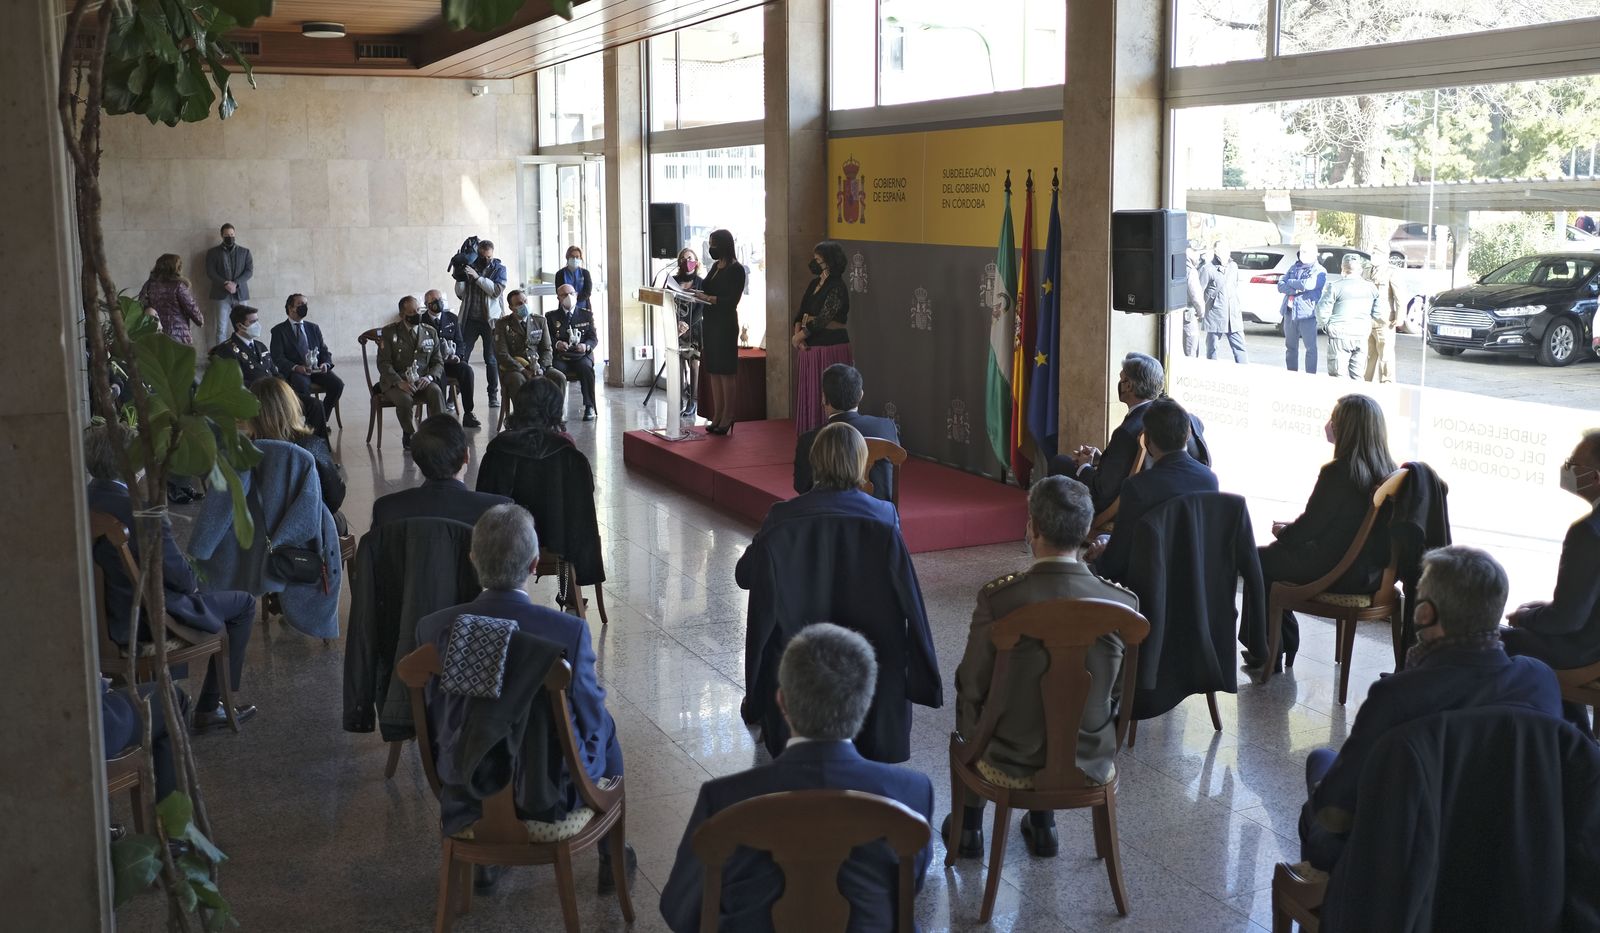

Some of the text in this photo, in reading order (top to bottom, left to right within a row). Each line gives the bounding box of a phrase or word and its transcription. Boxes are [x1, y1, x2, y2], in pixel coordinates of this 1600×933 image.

[942, 165, 997, 178] SUBDELEGACIÓN
[873, 177, 906, 188] GOBIERNO
[942, 183, 990, 193] DEL GOBIERNO
[873, 189, 905, 202] DE ESPAÑA
[942, 196, 986, 208] EN CÓRDOBA
